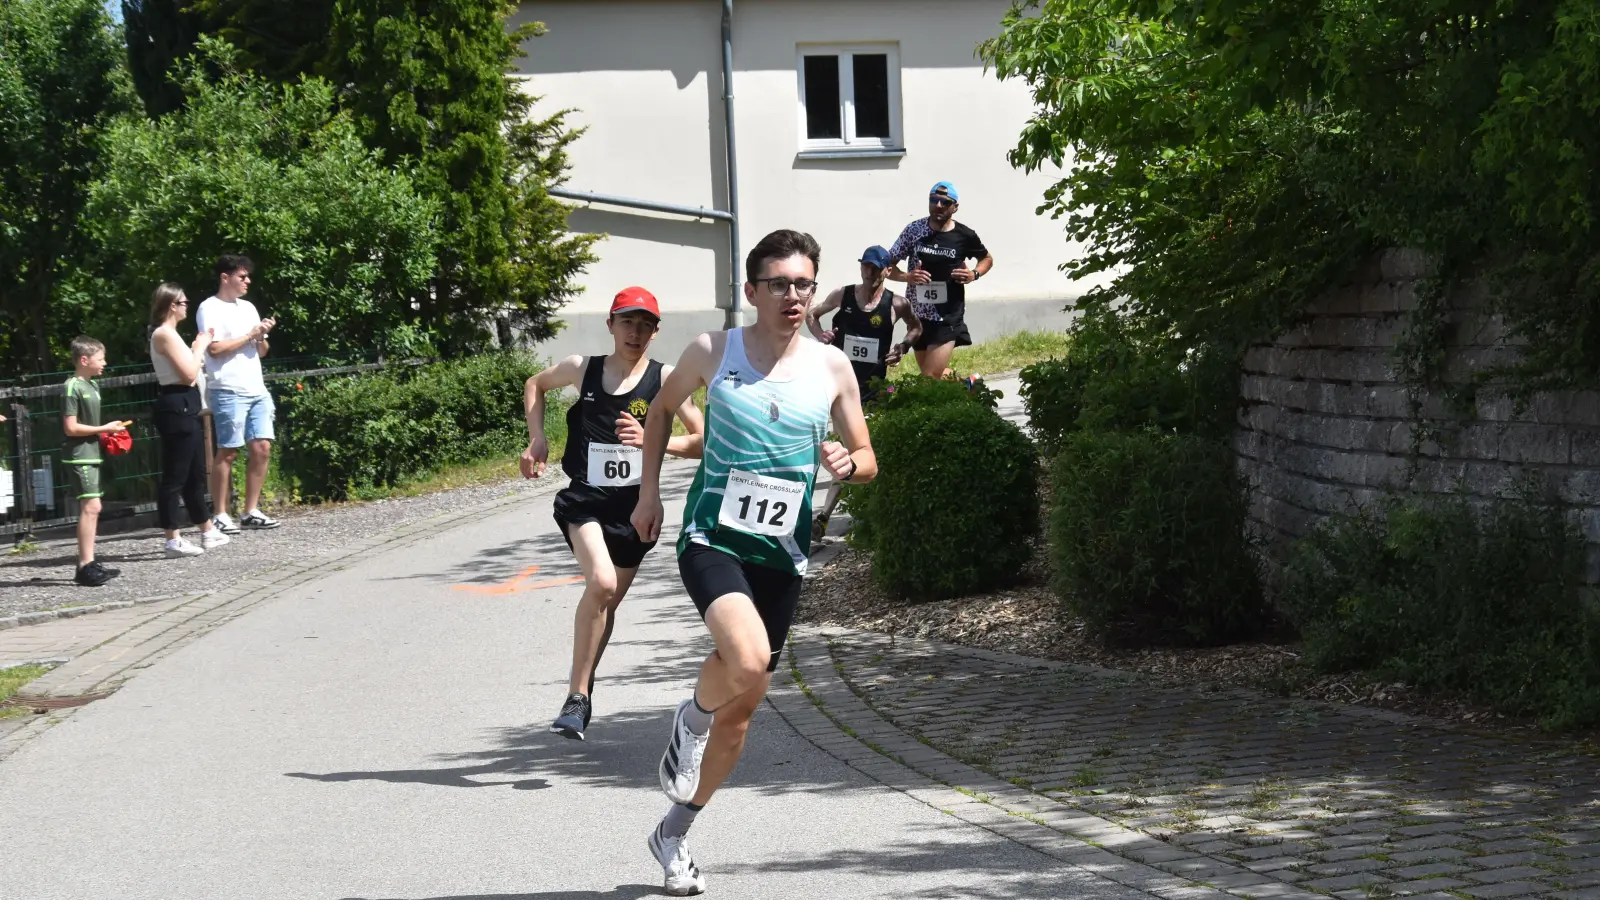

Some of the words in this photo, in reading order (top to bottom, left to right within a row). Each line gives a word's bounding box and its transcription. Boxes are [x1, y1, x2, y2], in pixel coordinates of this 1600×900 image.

[924, 290, 938, 300] 45
[852, 345, 868, 358] 59
[604, 460, 631, 479] 60
[731, 475, 769, 489] DENTLEINER
[769, 484, 802, 494] CROSSLAUF
[738, 494, 788, 527] 112
